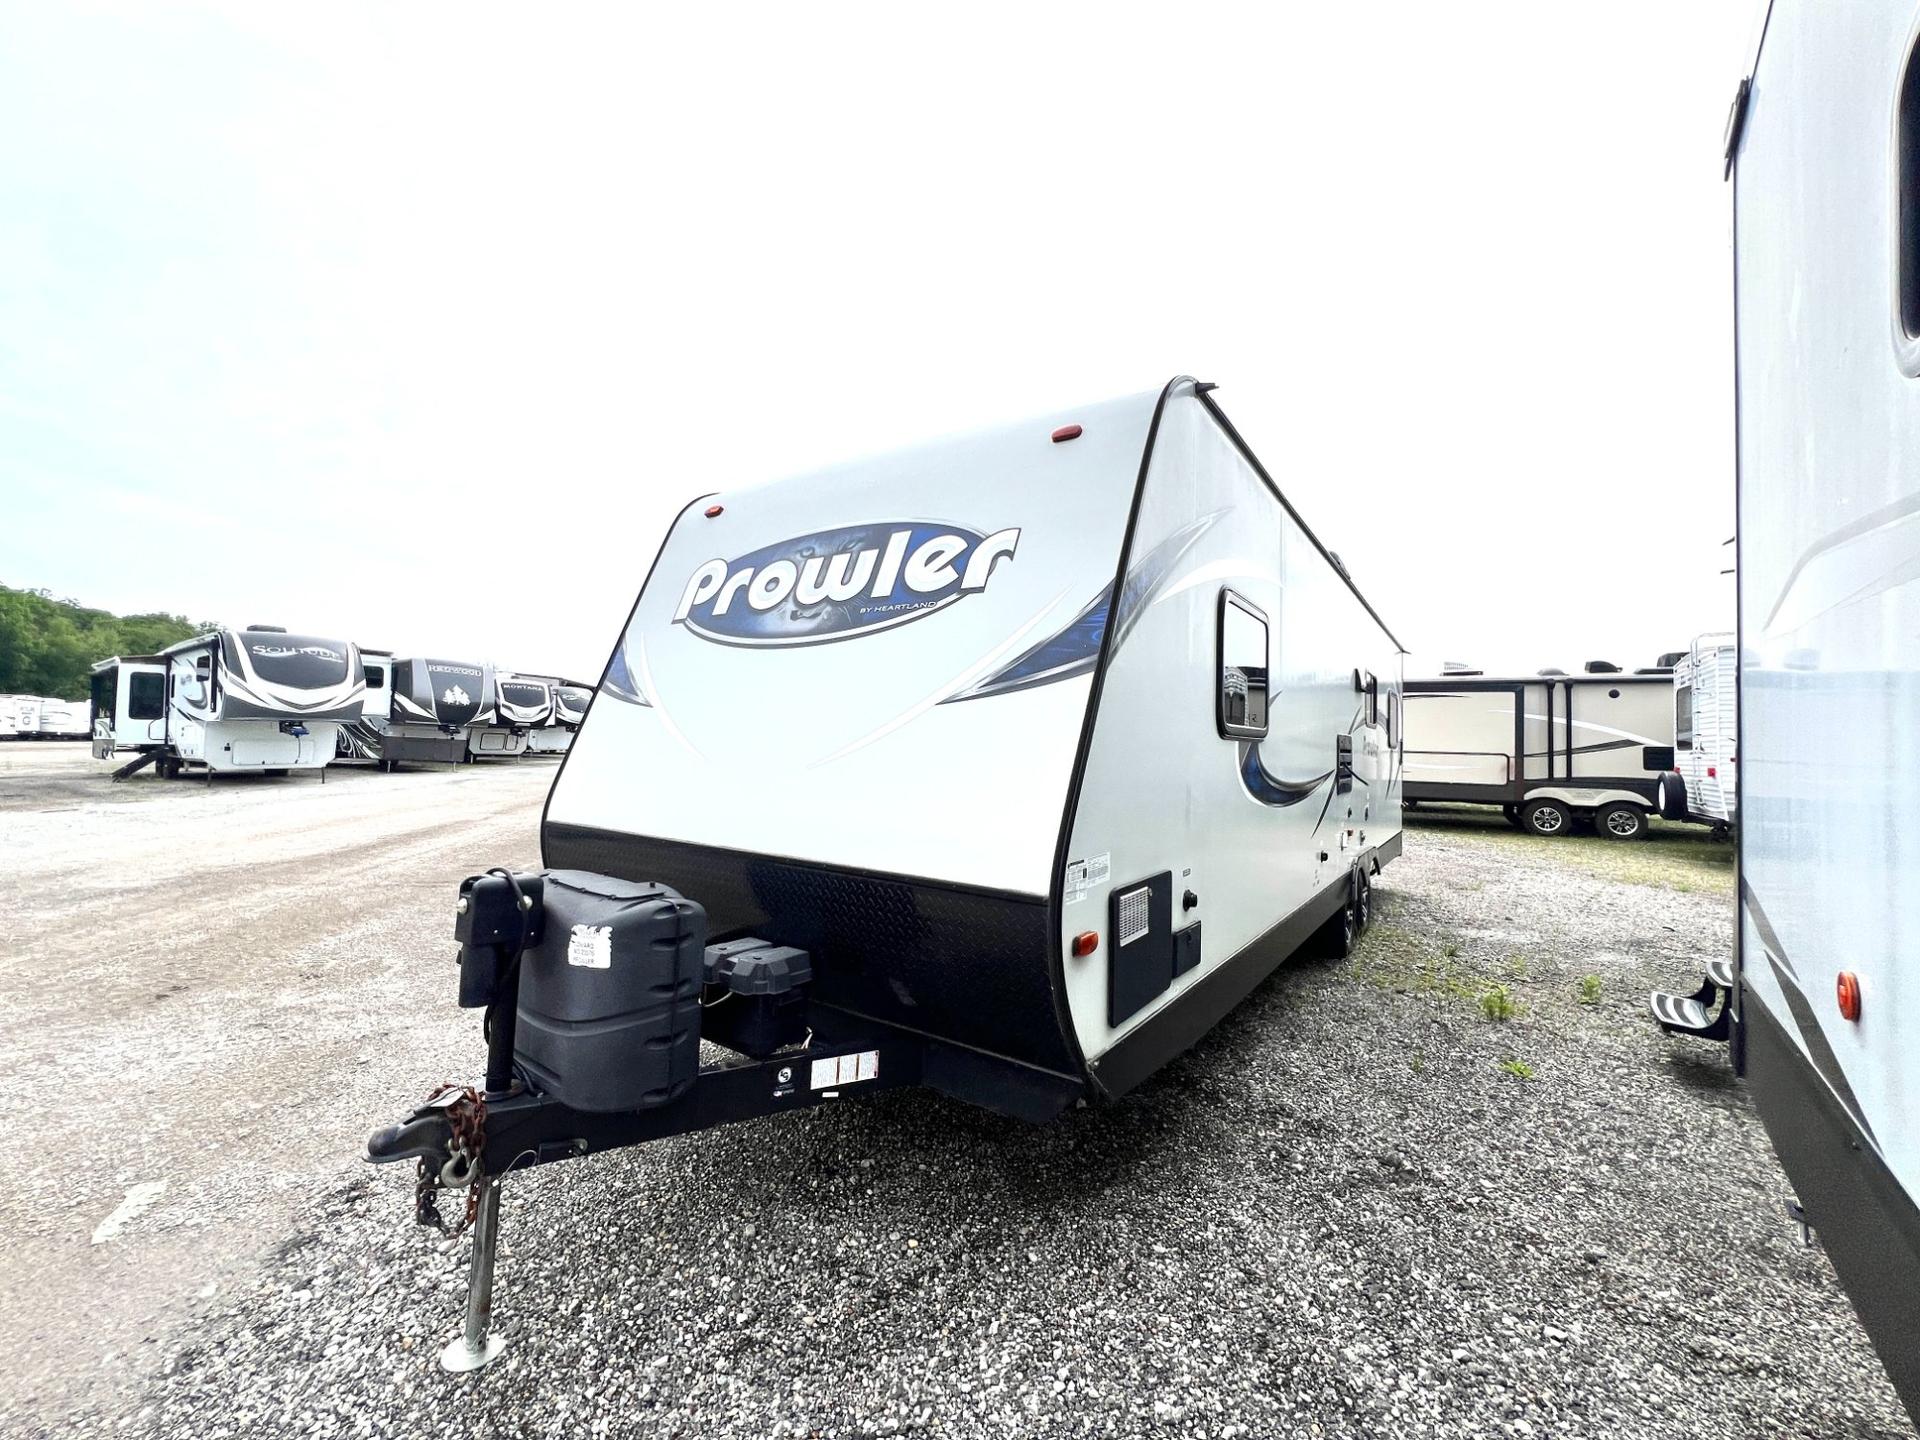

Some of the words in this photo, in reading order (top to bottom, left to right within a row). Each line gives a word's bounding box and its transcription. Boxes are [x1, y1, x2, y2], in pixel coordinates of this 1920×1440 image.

[671, 527, 1021, 624] Prowler
[860, 606, 873, 614] BY
[874, 601, 937, 612] HEARTLAND
[252, 645, 339, 659] SOLITUDE
[428, 664, 482, 677] REDWOOD
